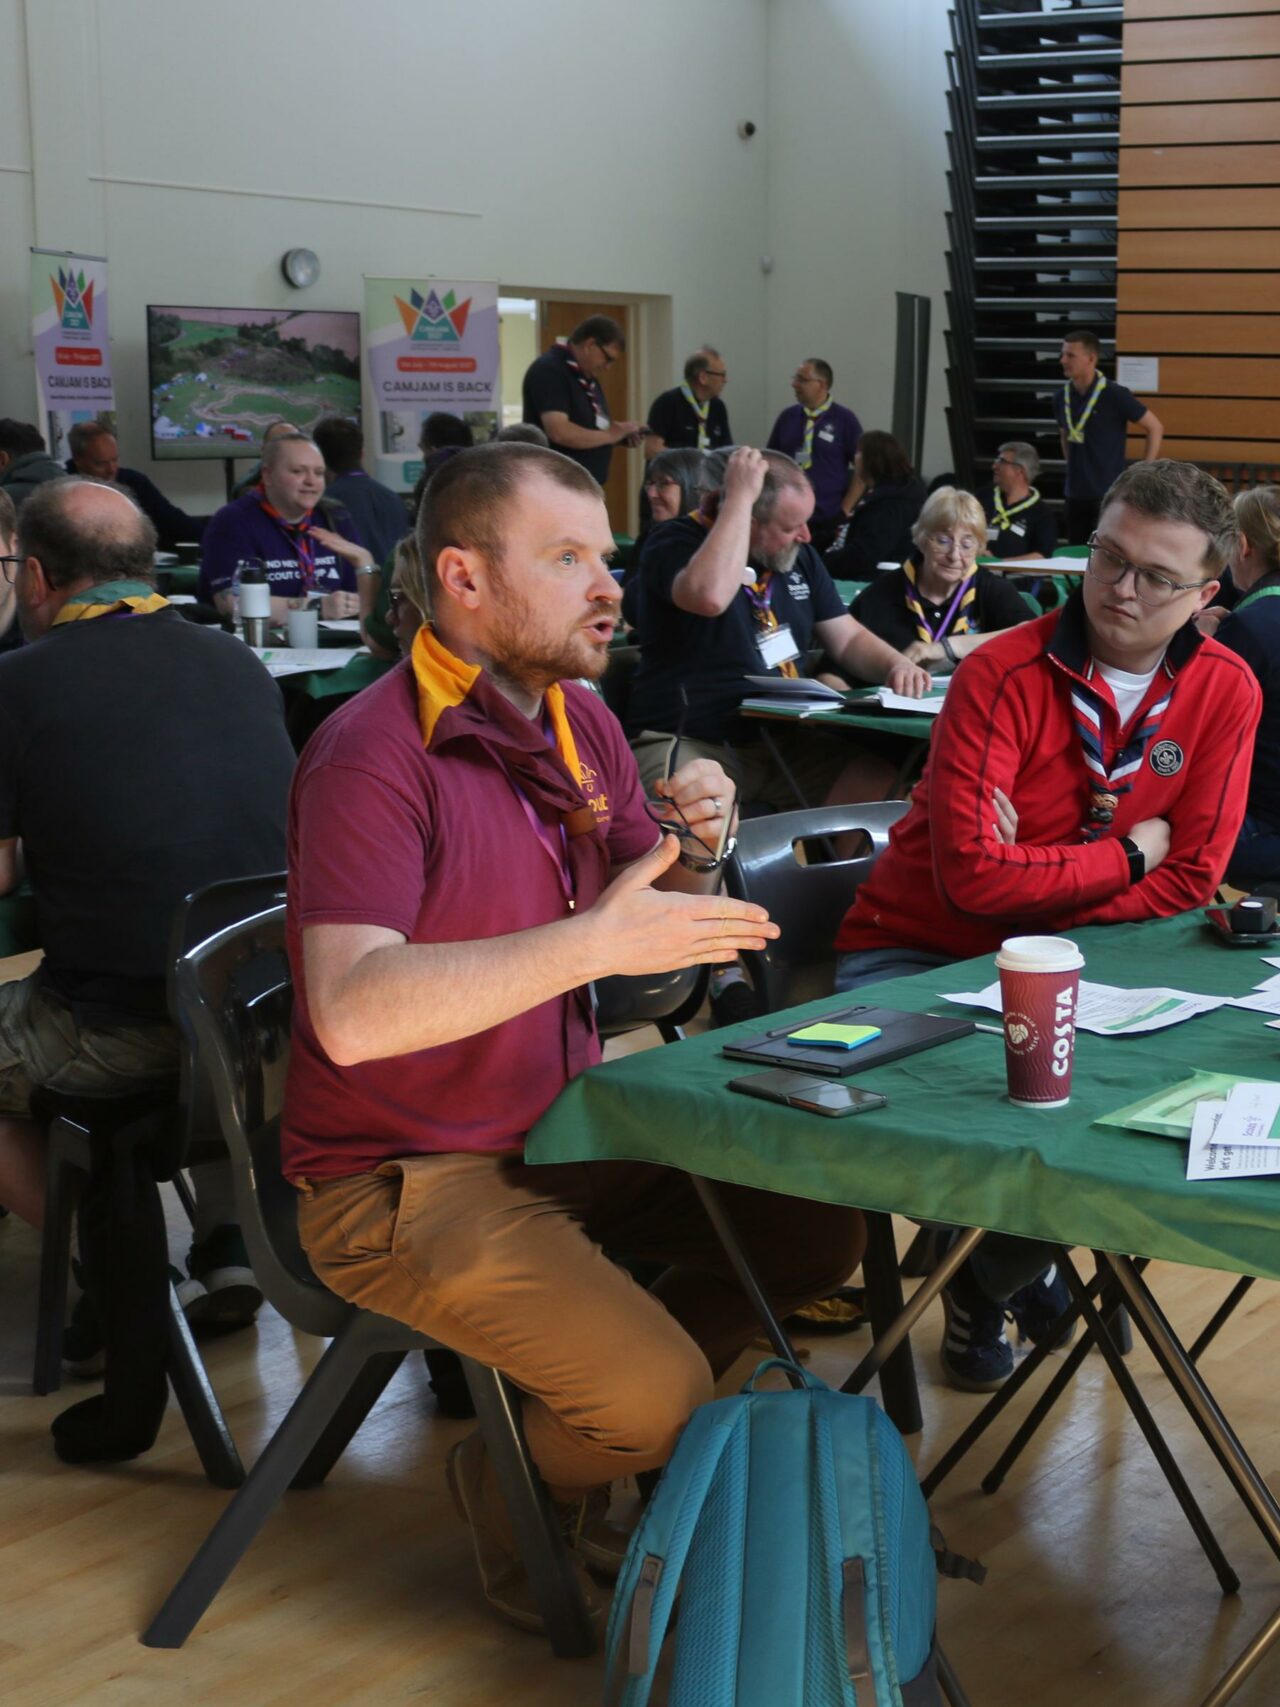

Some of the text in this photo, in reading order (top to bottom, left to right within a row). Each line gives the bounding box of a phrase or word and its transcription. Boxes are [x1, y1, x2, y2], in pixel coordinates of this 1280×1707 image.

[48, 375, 112, 389] CAMJAM IS BACK
[383, 381, 492, 392] CAMJAM IS BACK
[1052, 986, 1074, 1077] COSTA
[1203, 1144, 1217, 1171] Welcom
